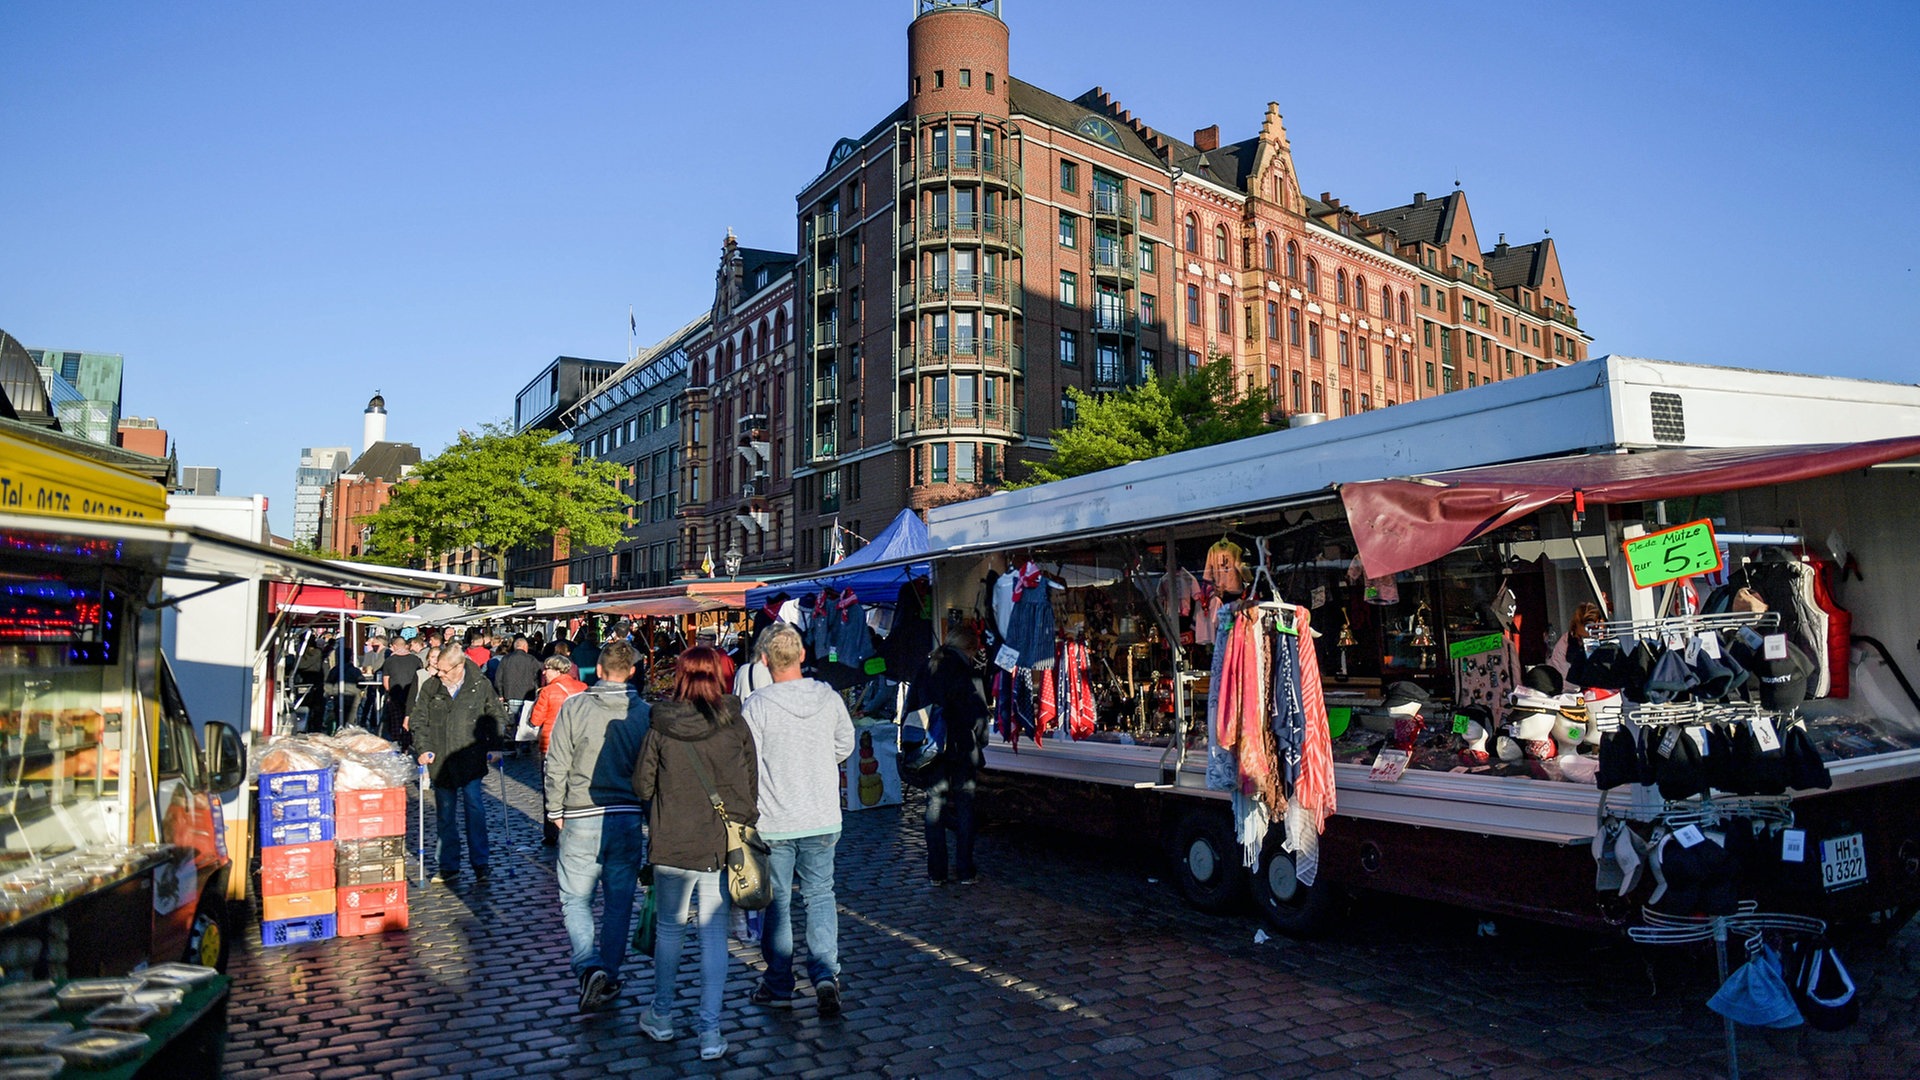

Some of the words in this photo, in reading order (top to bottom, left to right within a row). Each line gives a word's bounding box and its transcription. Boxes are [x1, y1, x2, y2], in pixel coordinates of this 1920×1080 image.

[1662, 527, 1701, 545] Mütze
[1835, 839, 1851, 861] HH
[1825, 864, 1834, 883] Q
[1836, 857, 1862, 881] 3327
